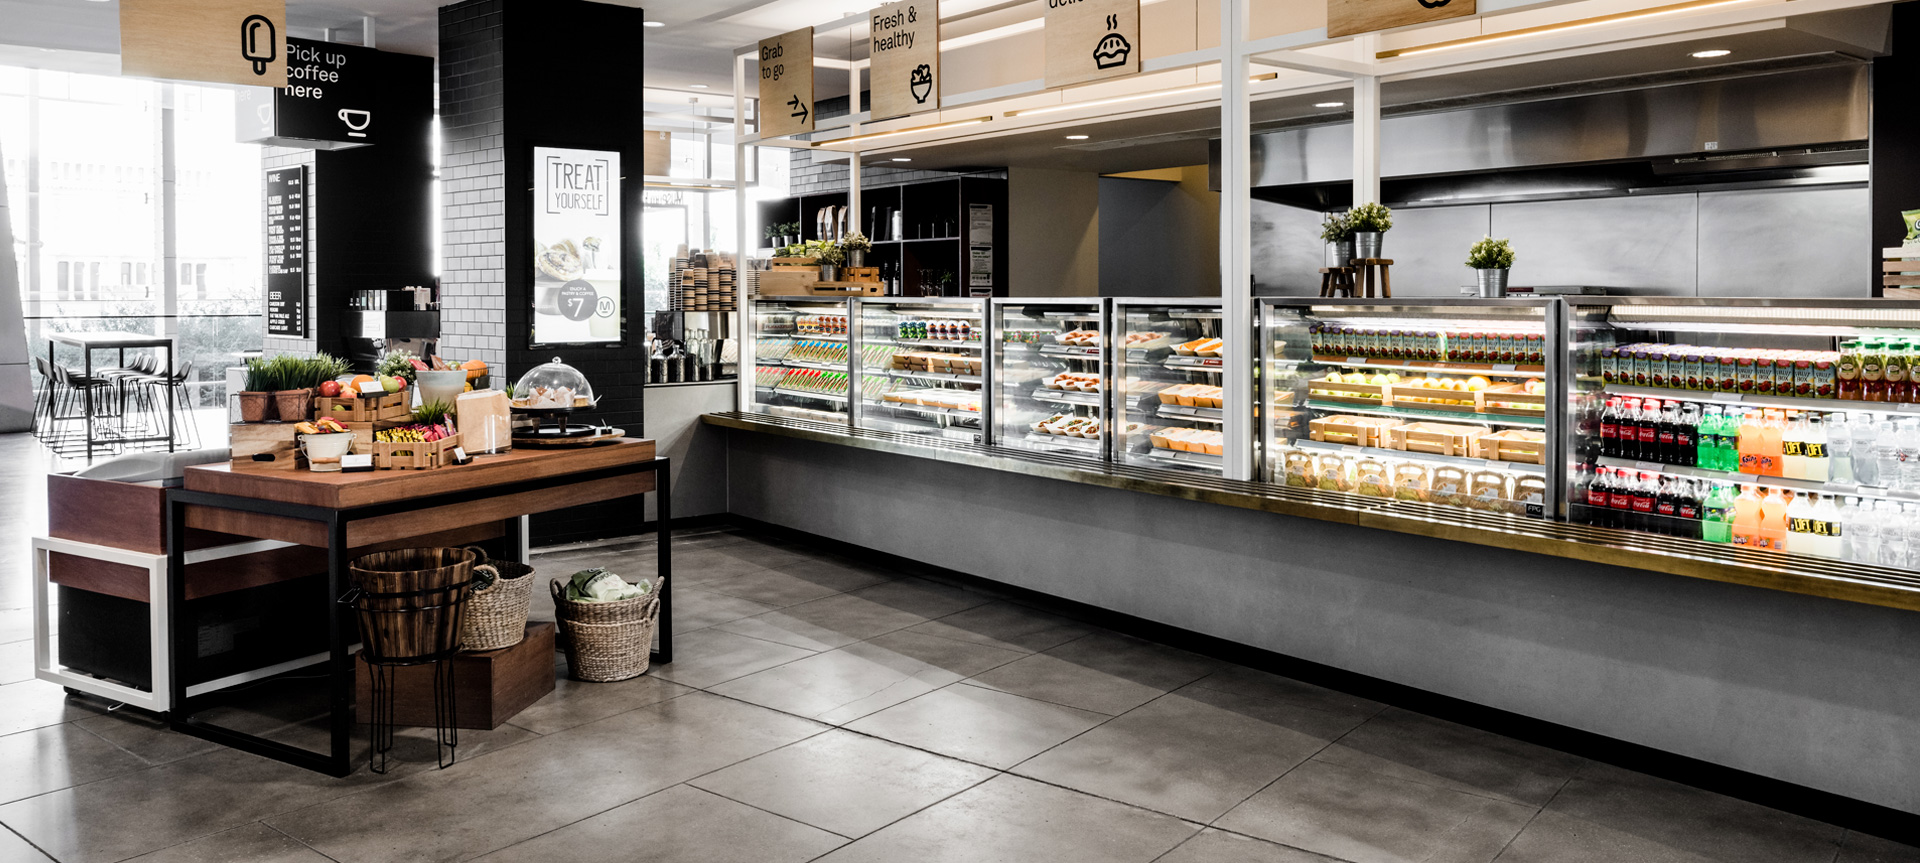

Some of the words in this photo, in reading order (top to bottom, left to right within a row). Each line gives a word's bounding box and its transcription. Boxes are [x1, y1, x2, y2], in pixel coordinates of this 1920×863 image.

[873, 10, 904, 32] Fresh
[908, 6, 917, 23] &
[873, 31, 915, 53] healthy
[326, 53, 346, 69] up
[761, 43, 783, 61] Grab
[287, 65, 339, 83] coffee
[762, 66, 771, 79] to
[773, 64, 784, 81] go
[552, 162, 603, 191] TREAT
[555, 192, 604, 210] YOURSELF
[568, 298, 584, 317] $7
[1528, 505, 1541, 513] FPG
